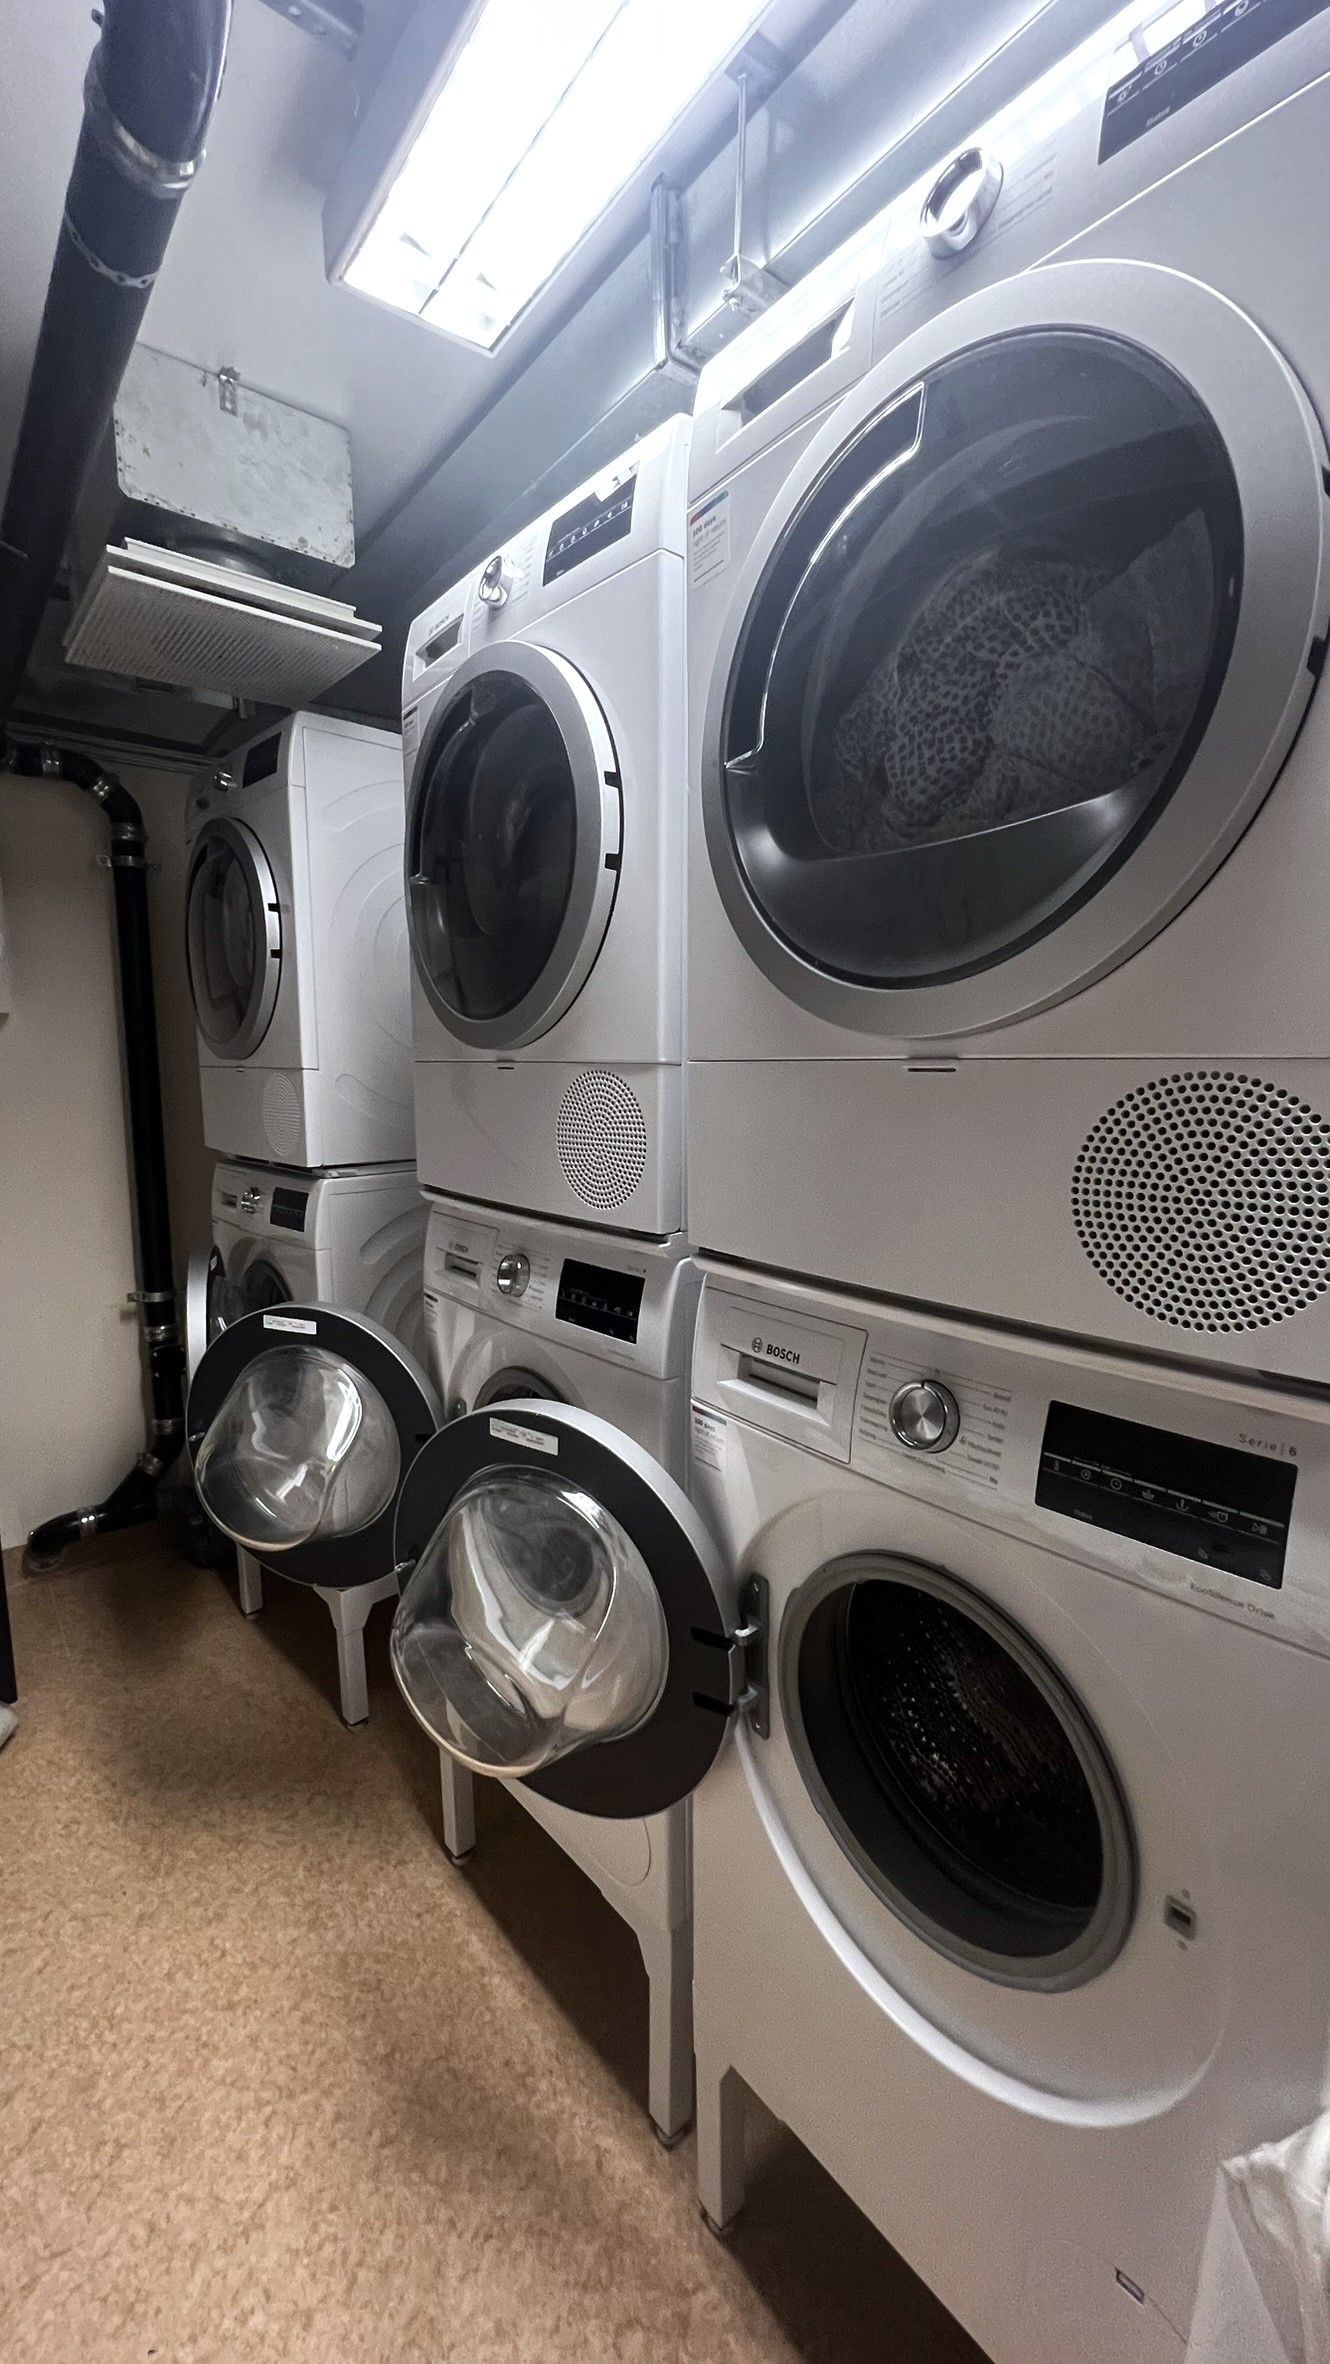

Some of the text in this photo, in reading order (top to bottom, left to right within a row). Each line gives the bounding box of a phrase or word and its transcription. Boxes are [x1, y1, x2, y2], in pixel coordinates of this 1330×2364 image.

[766, 1343, 800, 1364] BOSCH
[1239, 1433, 1297, 1457] Serie 6
